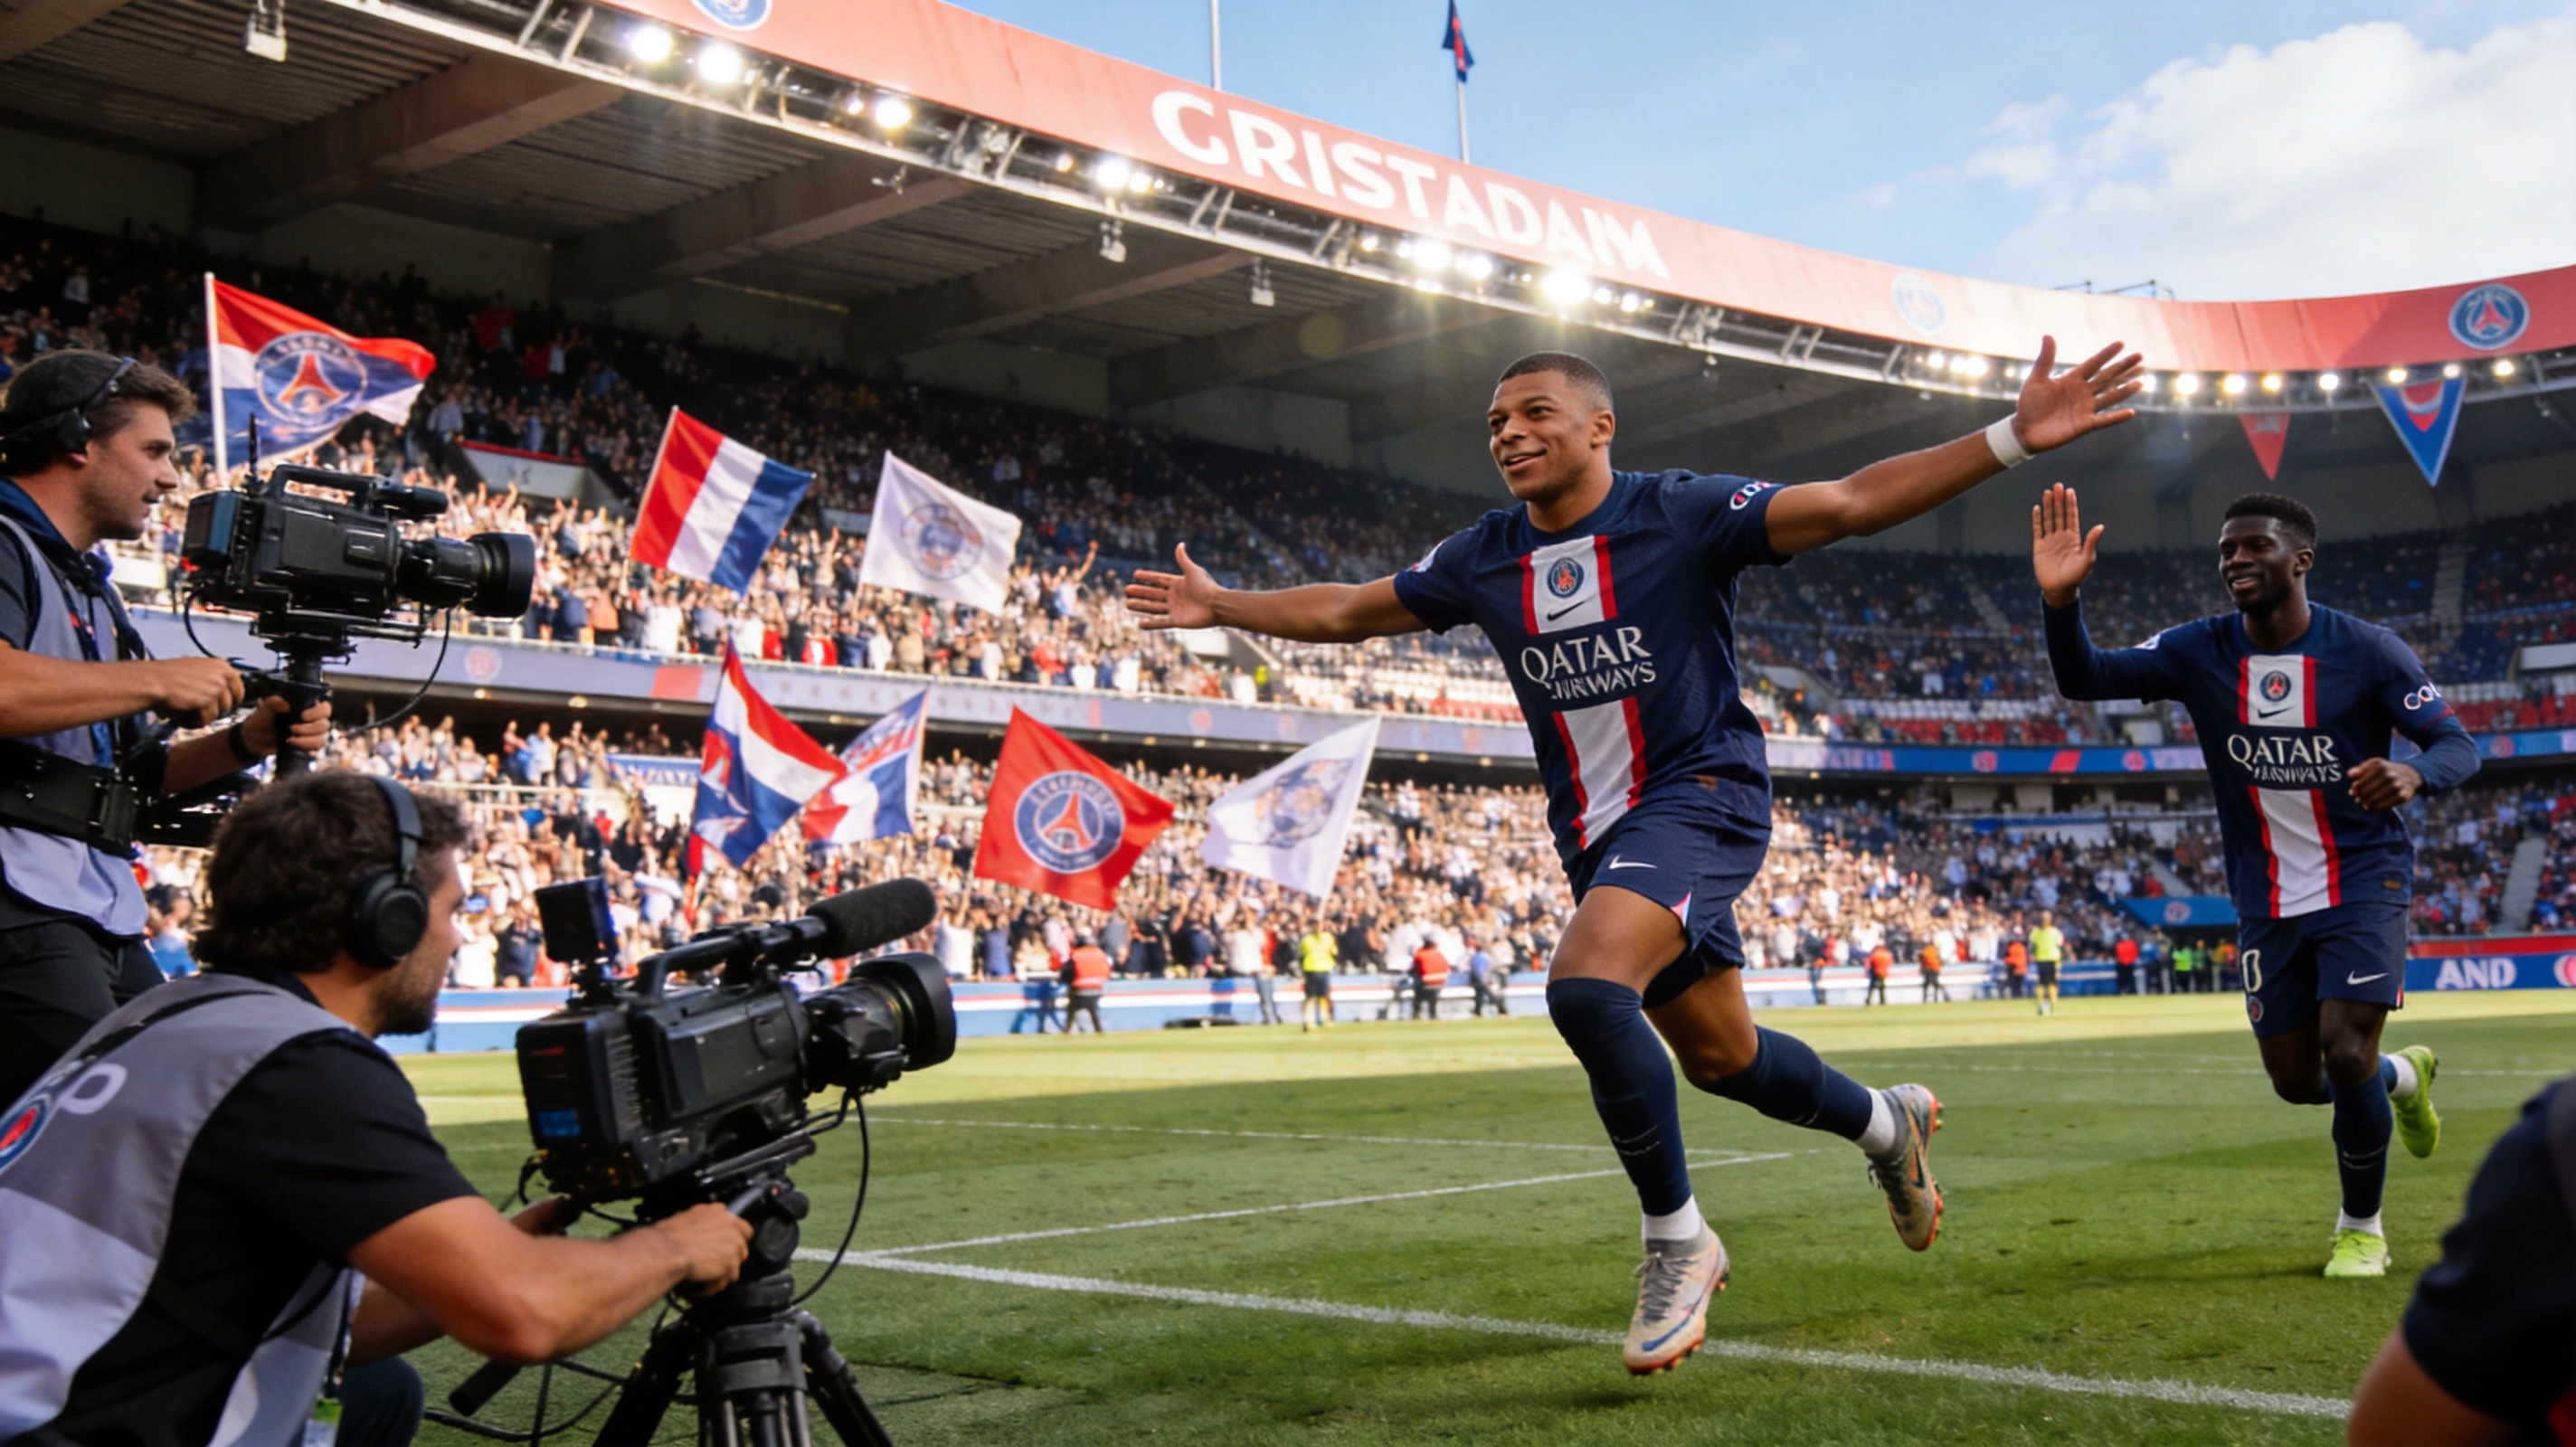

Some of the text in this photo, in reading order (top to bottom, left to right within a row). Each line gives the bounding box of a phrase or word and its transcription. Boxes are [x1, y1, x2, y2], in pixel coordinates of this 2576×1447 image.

[1520, 626, 1653, 690] QATAR
[2227, 733, 2339, 771] QATAR
[2435, 957, 2517, 990] AND
